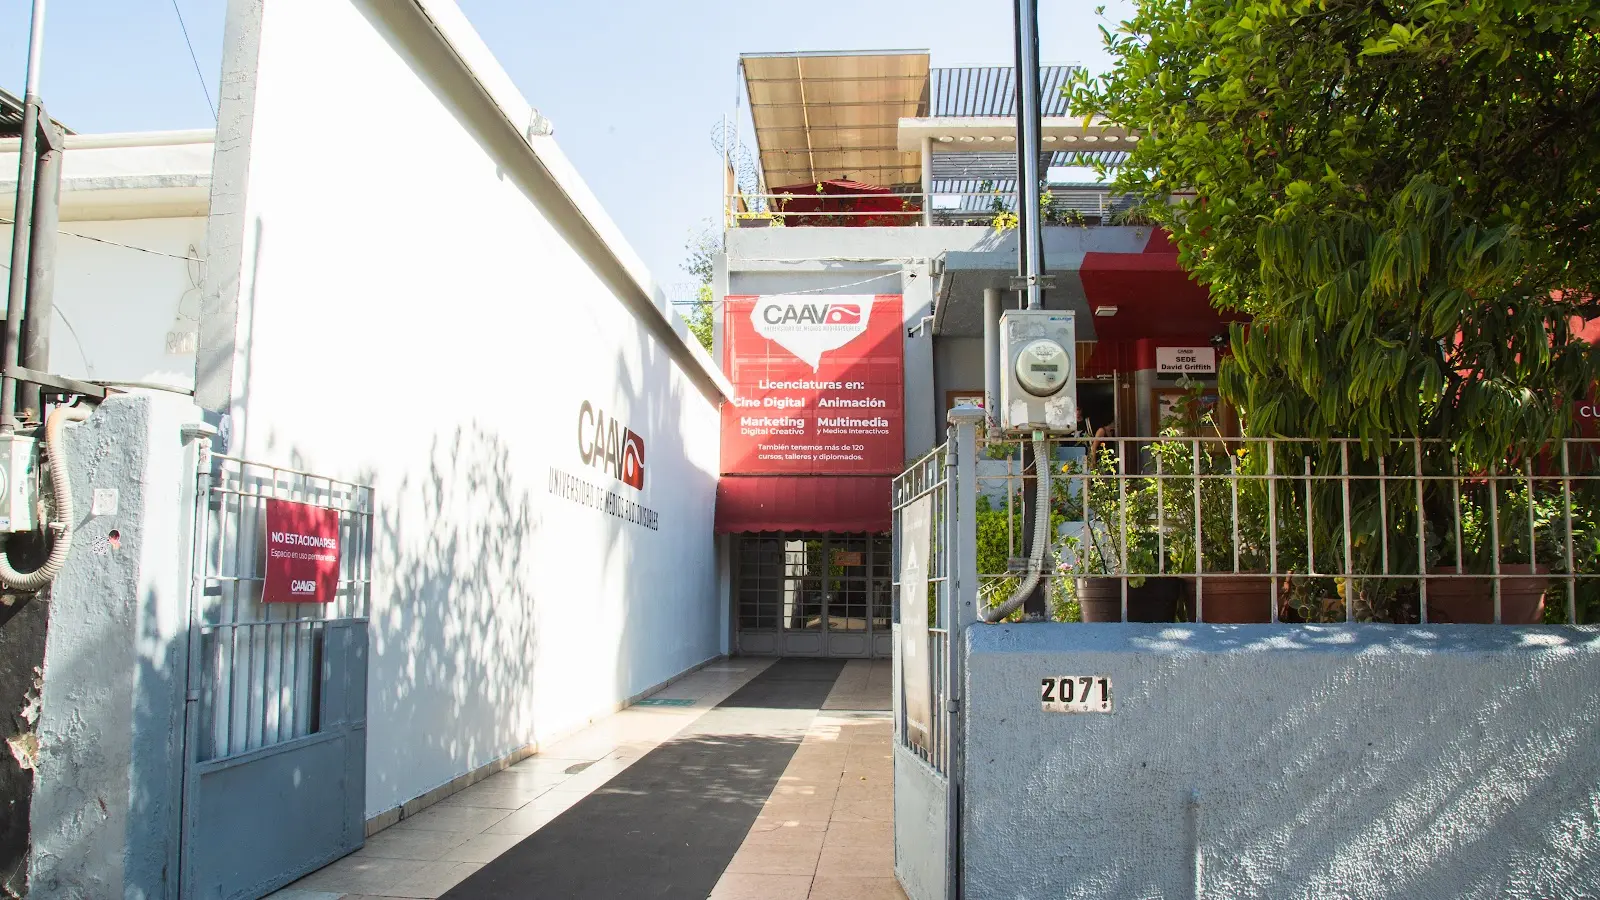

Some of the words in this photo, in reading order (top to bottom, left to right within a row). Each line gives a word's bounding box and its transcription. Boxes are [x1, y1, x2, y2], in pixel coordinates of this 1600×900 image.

[763, 303, 829, 325] CAAV
[1184, 363, 1212, 371] Griffith
[759, 379, 842, 390] Licenciaturas
[846, 381, 865, 390] en:
[734, 397, 761, 408] Cine
[763, 397, 806, 410] Digital
[818, 396, 886, 408] Animación
[740, 416, 805, 429] Marketing
[817, 416, 889, 428] Multimedia
[741, 427, 769, 436] Digital
[770, 427, 805, 435] Creativo
[822, 427, 848, 435] Medios
[849, 427, 889, 435] Interactivos
[577, 399, 628, 481] CAAV
[758, 443, 790, 451] También
[824, 443, 841, 451] más
[841, 443, 851, 451] de
[852, 443, 865, 451] 120
[819, 453, 864, 461] diplomados.
[271, 531, 284, 543] NO
[285, 533, 336, 549] ESTACIONARSE
[271, 548, 292, 558] Espacio
[299, 552, 308, 560] uso
[308, 553, 337, 562] permanente
[291, 580, 308, 591] CAAV
[1041, 677, 1108, 702] 2071
